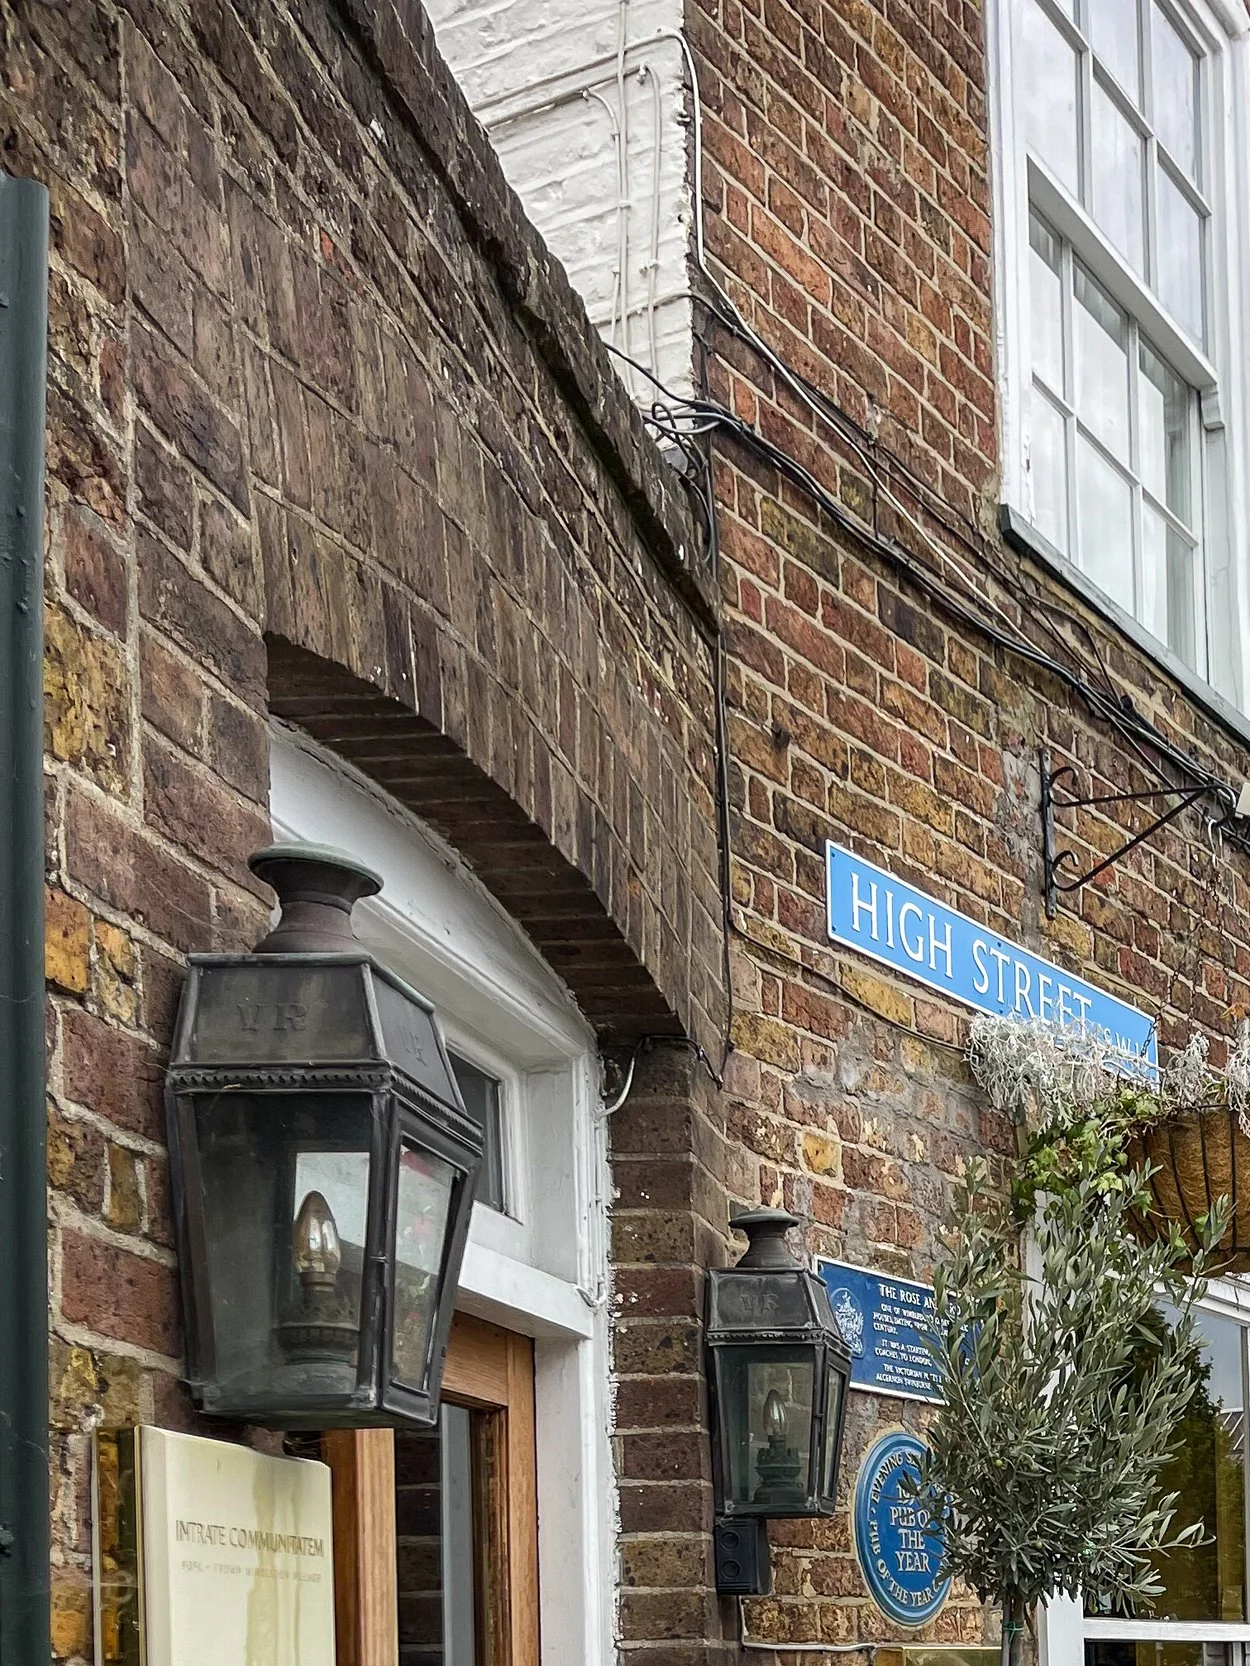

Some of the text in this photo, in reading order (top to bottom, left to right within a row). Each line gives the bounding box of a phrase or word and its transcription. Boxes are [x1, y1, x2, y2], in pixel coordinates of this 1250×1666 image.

[851, 872, 953, 978] HIGH
[972, 939, 1092, 1041] STREET
[878, 1283, 897, 1300] THE
[900, 1289, 921, 1306] ROSE
[923, 1296, 938, 1311] AN
[871, 1451, 904, 1505] EVENING
[890, 1506, 930, 1528] PUB O
[176, 1519, 325, 1558] INTRATE COMMUNITATEM
[898, 1528, 925, 1549] THE
[869, 1519, 935, 1607] PUB OF THE YEAR
[895, 1551, 932, 1573] YEAR
